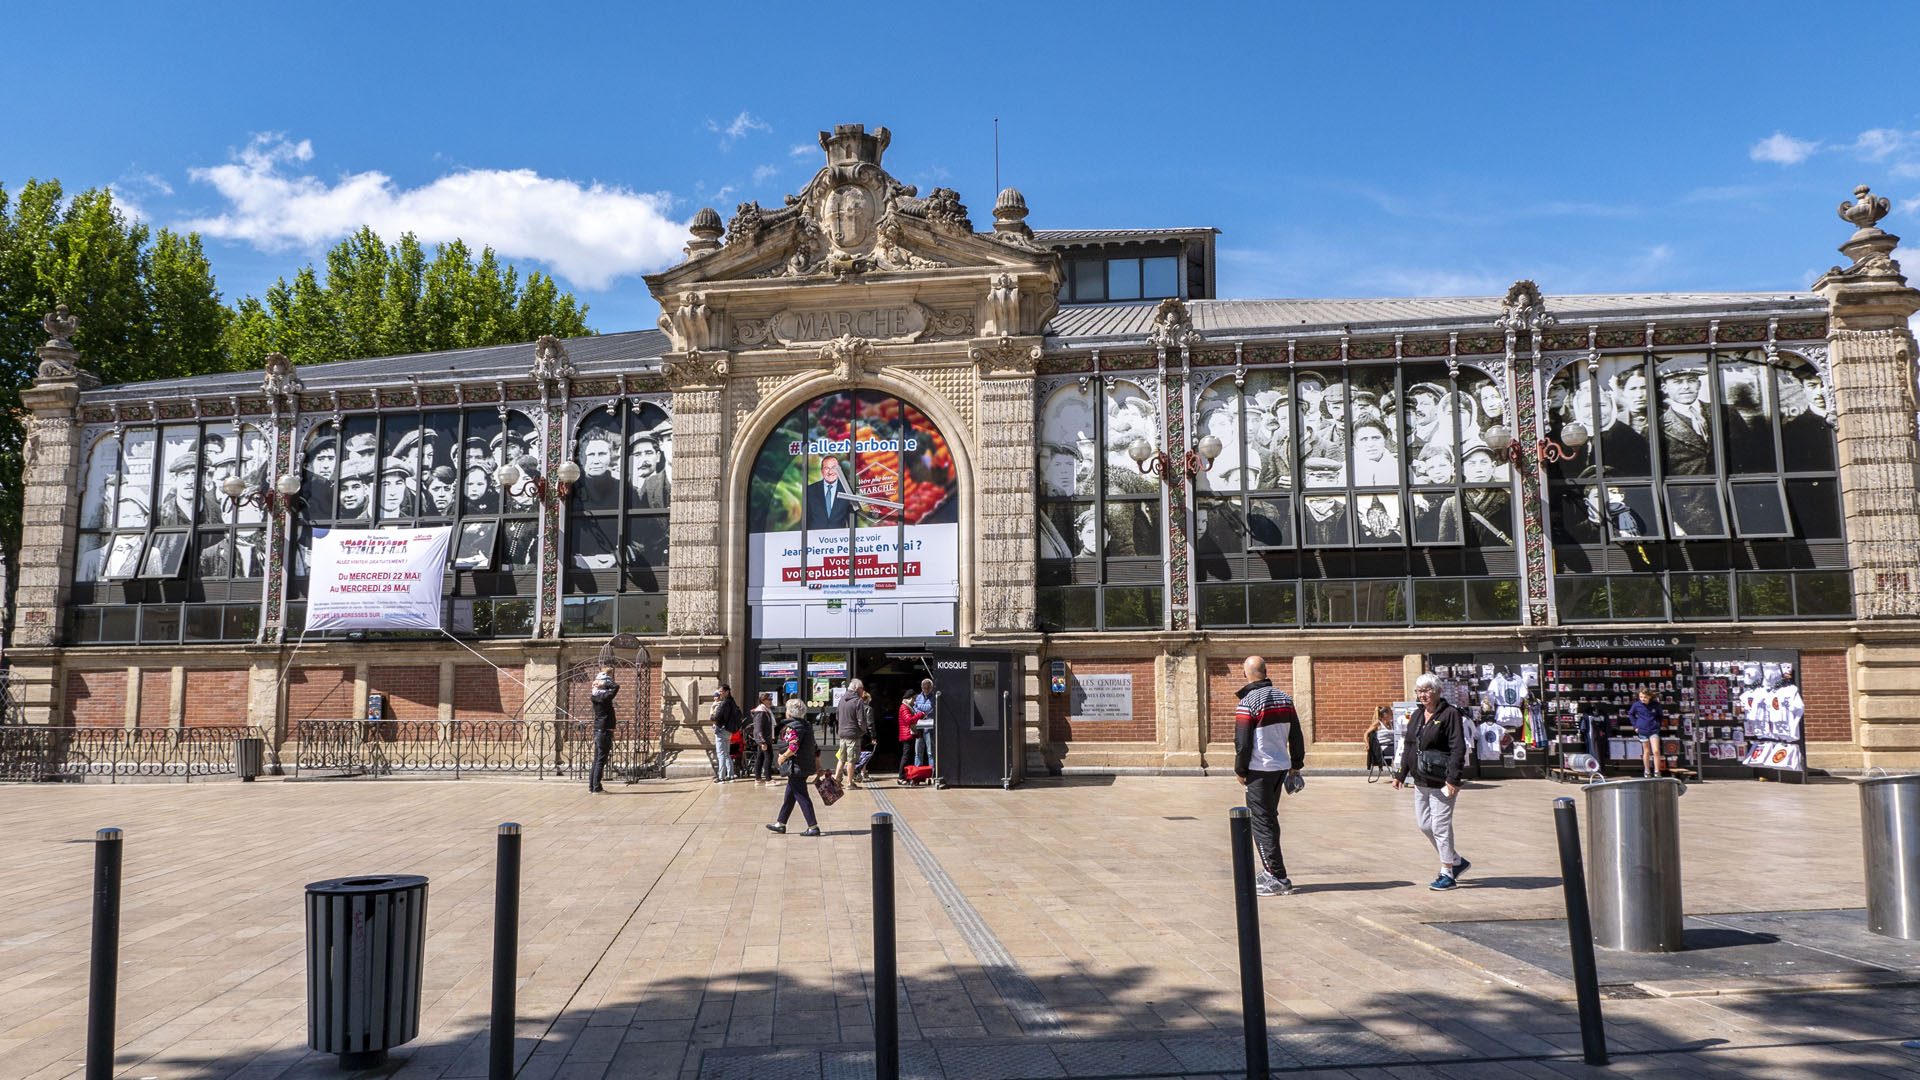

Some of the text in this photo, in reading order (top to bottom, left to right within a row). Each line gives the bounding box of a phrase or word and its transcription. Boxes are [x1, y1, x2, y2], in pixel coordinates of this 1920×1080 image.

[795, 308, 909, 341] MARCHE
[859, 482, 895, 496] MARCHÉ
[818, 533, 881, 544] Vous voez voir
[805, 545, 835, 555] Pierre
[836, 543, 874, 555] Penaut
[876, 543, 889, 552] en
[892, 540, 914, 552] vai
[916, 540, 922, 551] ?
[829, 557, 872, 566] Vote sur
[349, 572, 391, 580] MERCREDI
[392, 572, 403, 580] 22
[404, 572, 420, 580] MAI
[330, 584, 409, 593] Au MERCREDI 29 MAI
[331, 611, 341, 619] LES
[1576, 636, 1609, 649] Kiosque
[1622, 635, 1666, 647] Souvenirs
[937, 661, 968, 670] KIOSQUE
[1097, 679, 1131, 687] CENTRALES
